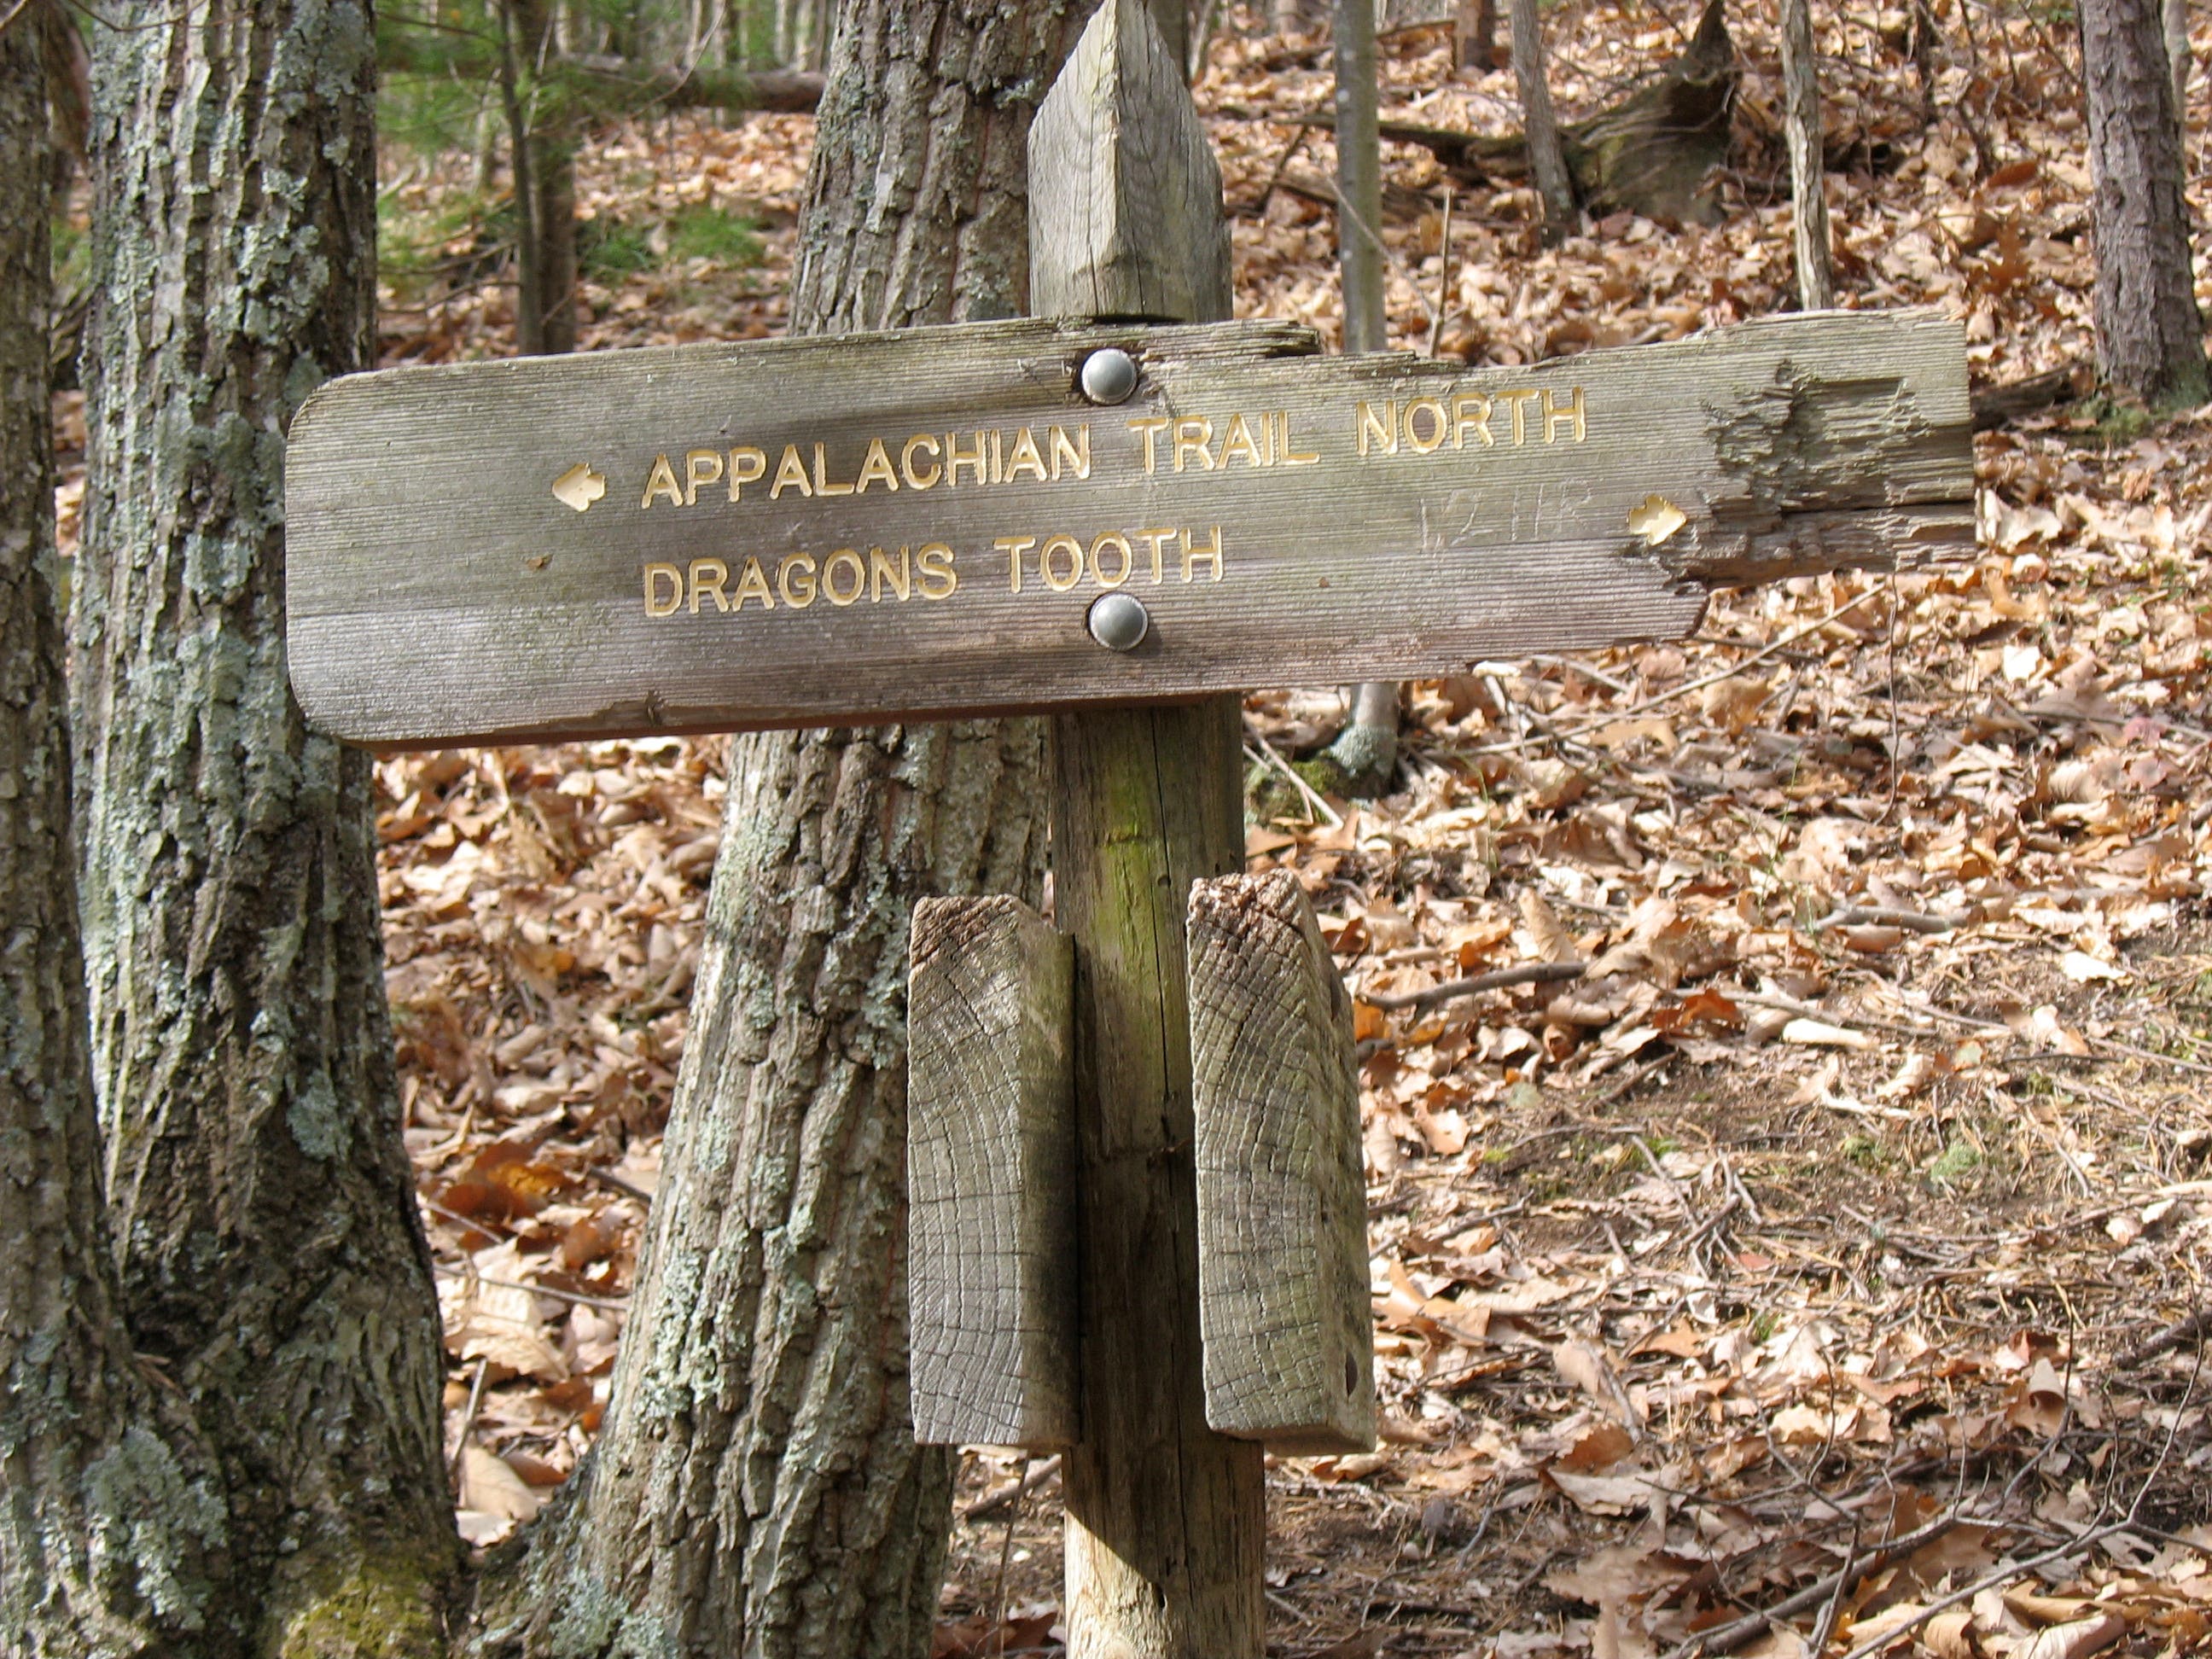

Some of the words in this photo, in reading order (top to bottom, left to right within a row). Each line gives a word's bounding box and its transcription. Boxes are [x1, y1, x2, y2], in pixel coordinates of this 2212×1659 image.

[642, 424, 1091, 509] APPALACHIAN
[1127, 410, 1319, 474] TRAIL
[1355, 387, 1586, 456] NORTH
[643, 545, 958, 617] DRAGONS
[993, 527, 1224, 591] TOOTH
